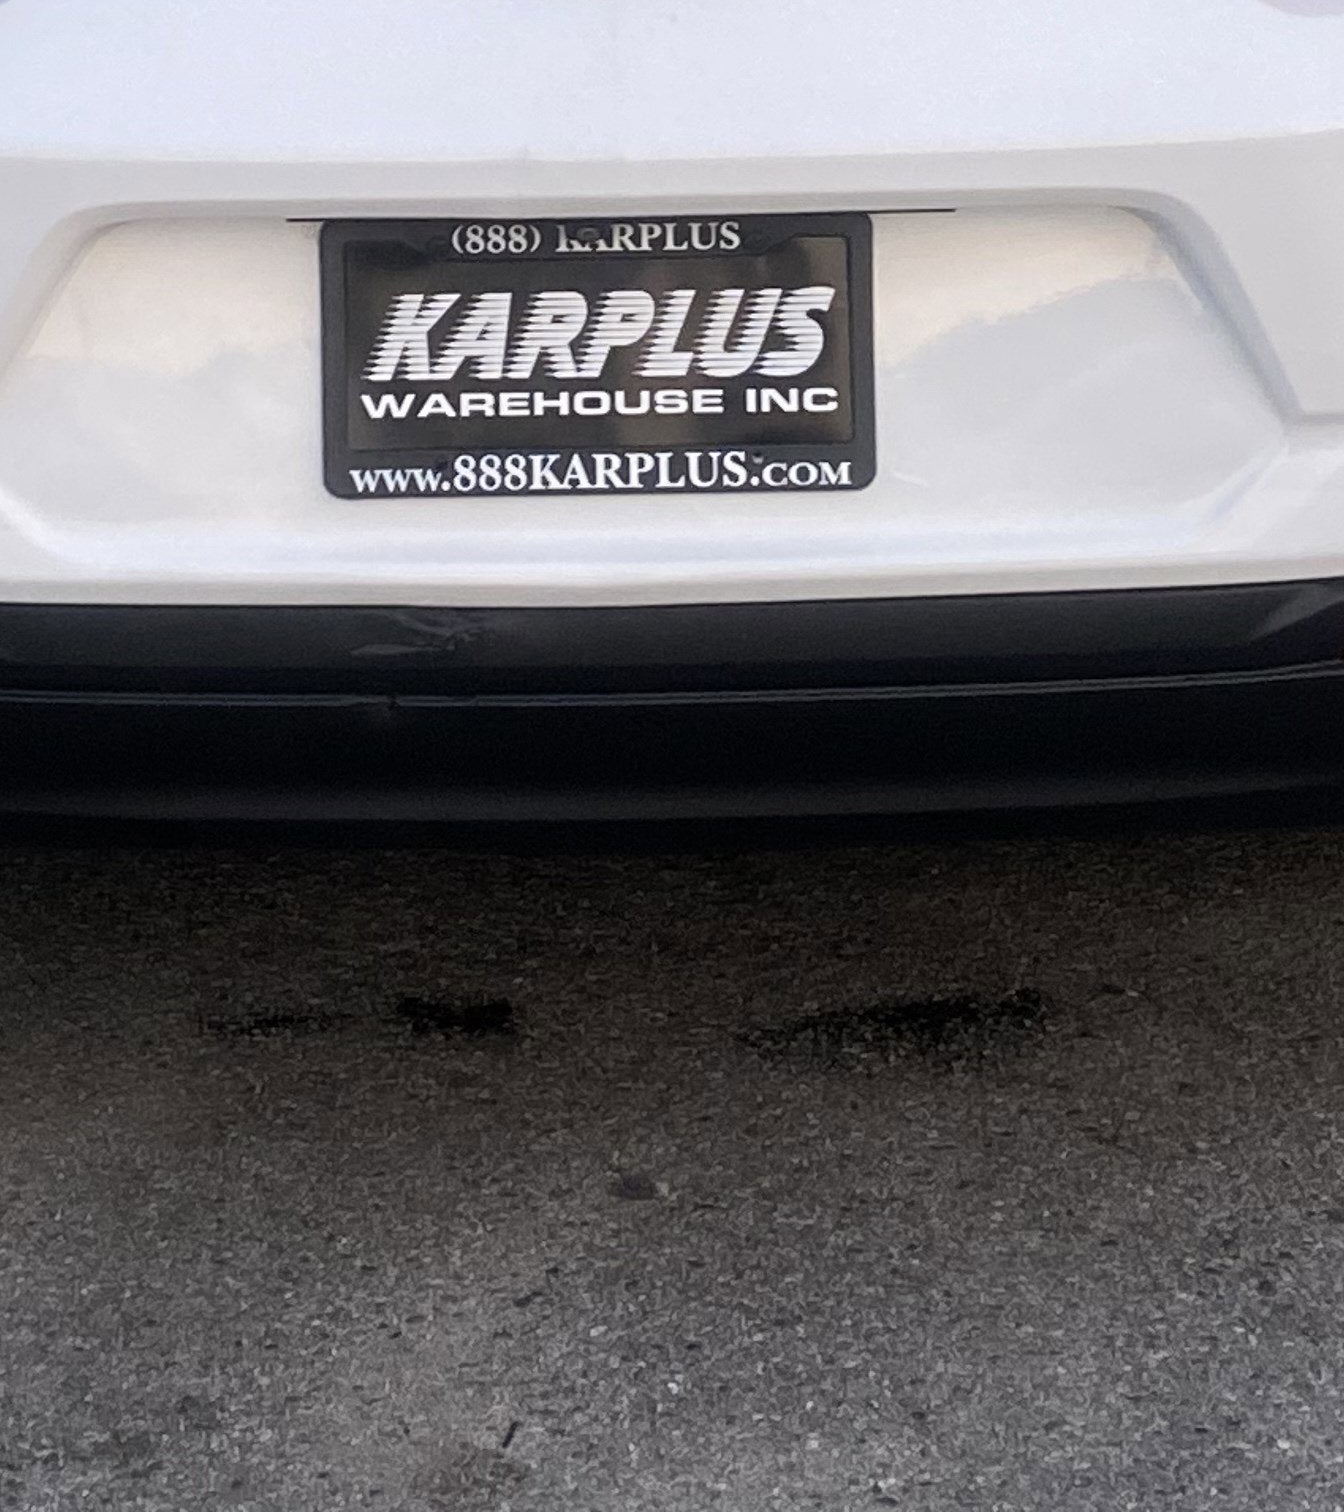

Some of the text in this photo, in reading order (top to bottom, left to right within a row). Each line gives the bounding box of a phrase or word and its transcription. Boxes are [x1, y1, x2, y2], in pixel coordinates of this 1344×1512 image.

[451, 223, 541, 254] (888)
[360, 286, 836, 382] KARPLUS
[361, 388, 838, 419] WAREHOUSE INC
